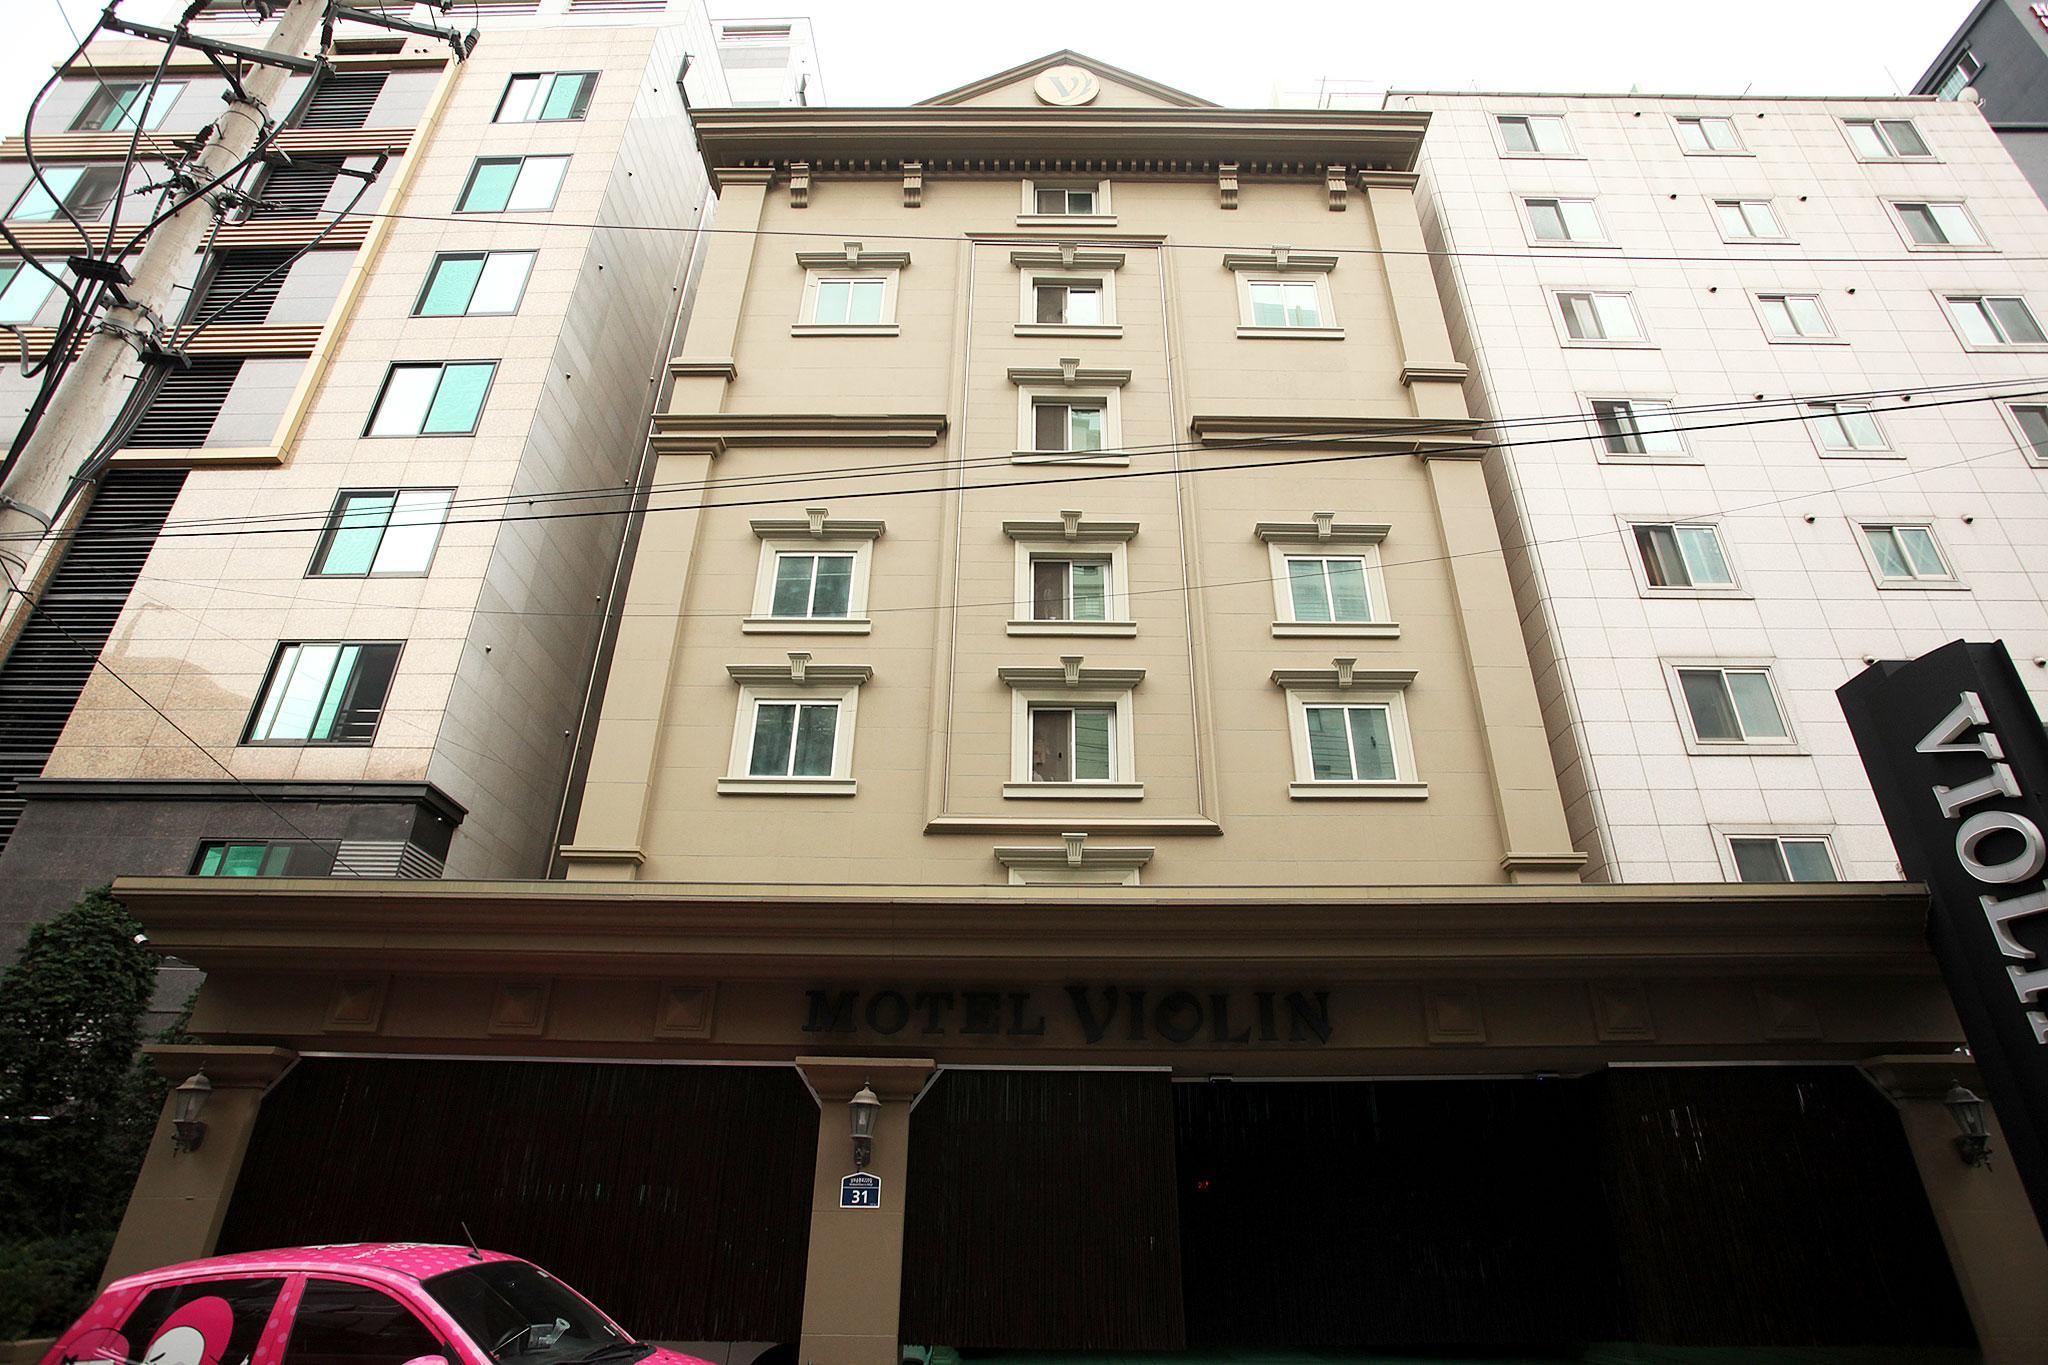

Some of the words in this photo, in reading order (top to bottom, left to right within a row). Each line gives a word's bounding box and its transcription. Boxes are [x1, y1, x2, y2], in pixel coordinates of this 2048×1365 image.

[1915, 690, 2048, 1045] VIOLI
[802, 990, 1046, 1035] MOTEL
[1064, 985, 1334, 1045] VIOLIN
[851, 1190, 868, 1204] 31
